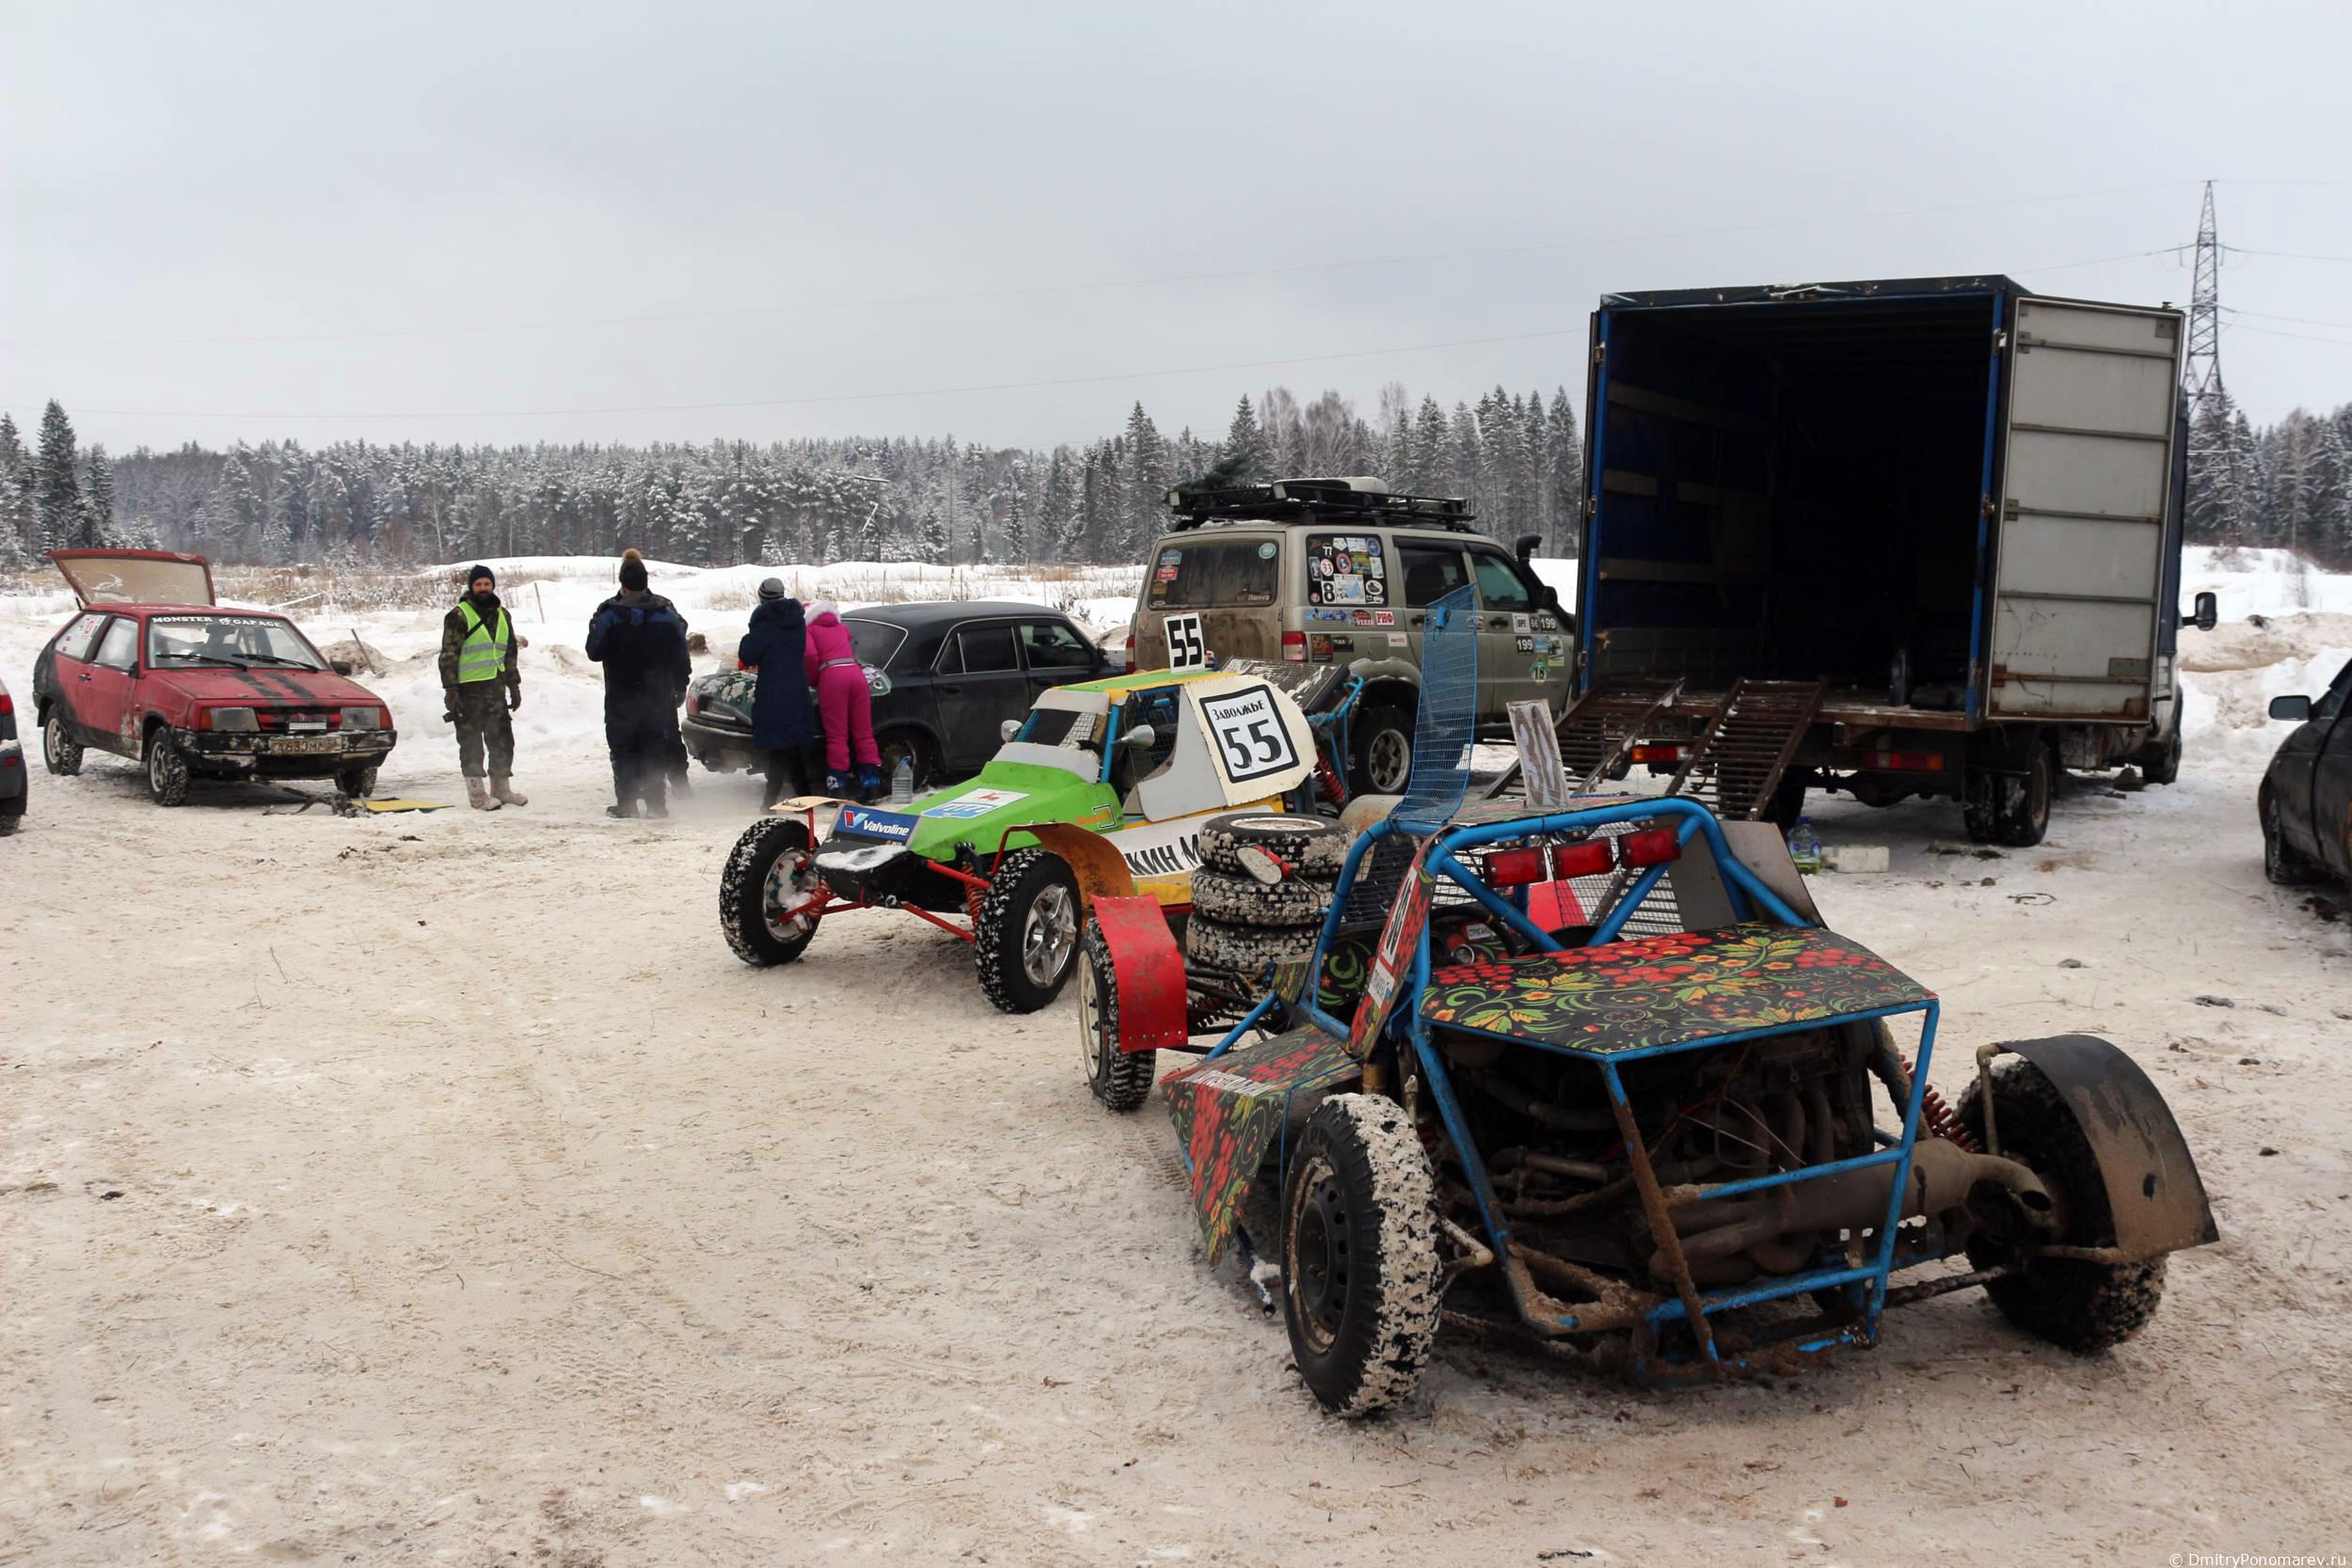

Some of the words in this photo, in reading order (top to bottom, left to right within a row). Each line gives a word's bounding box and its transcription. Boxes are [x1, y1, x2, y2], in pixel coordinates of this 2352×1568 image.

[1324, 582, 1335, 602] 8
[1541, 617, 1556, 628] 199
[1167, 617, 1202, 668] 55
[1517, 639, 1533, 650] 199
[1222, 719, 1282, 769] 55
[863, 819, 910, 836] Valvoline
[1124, 845, 1185, 876] КИН
